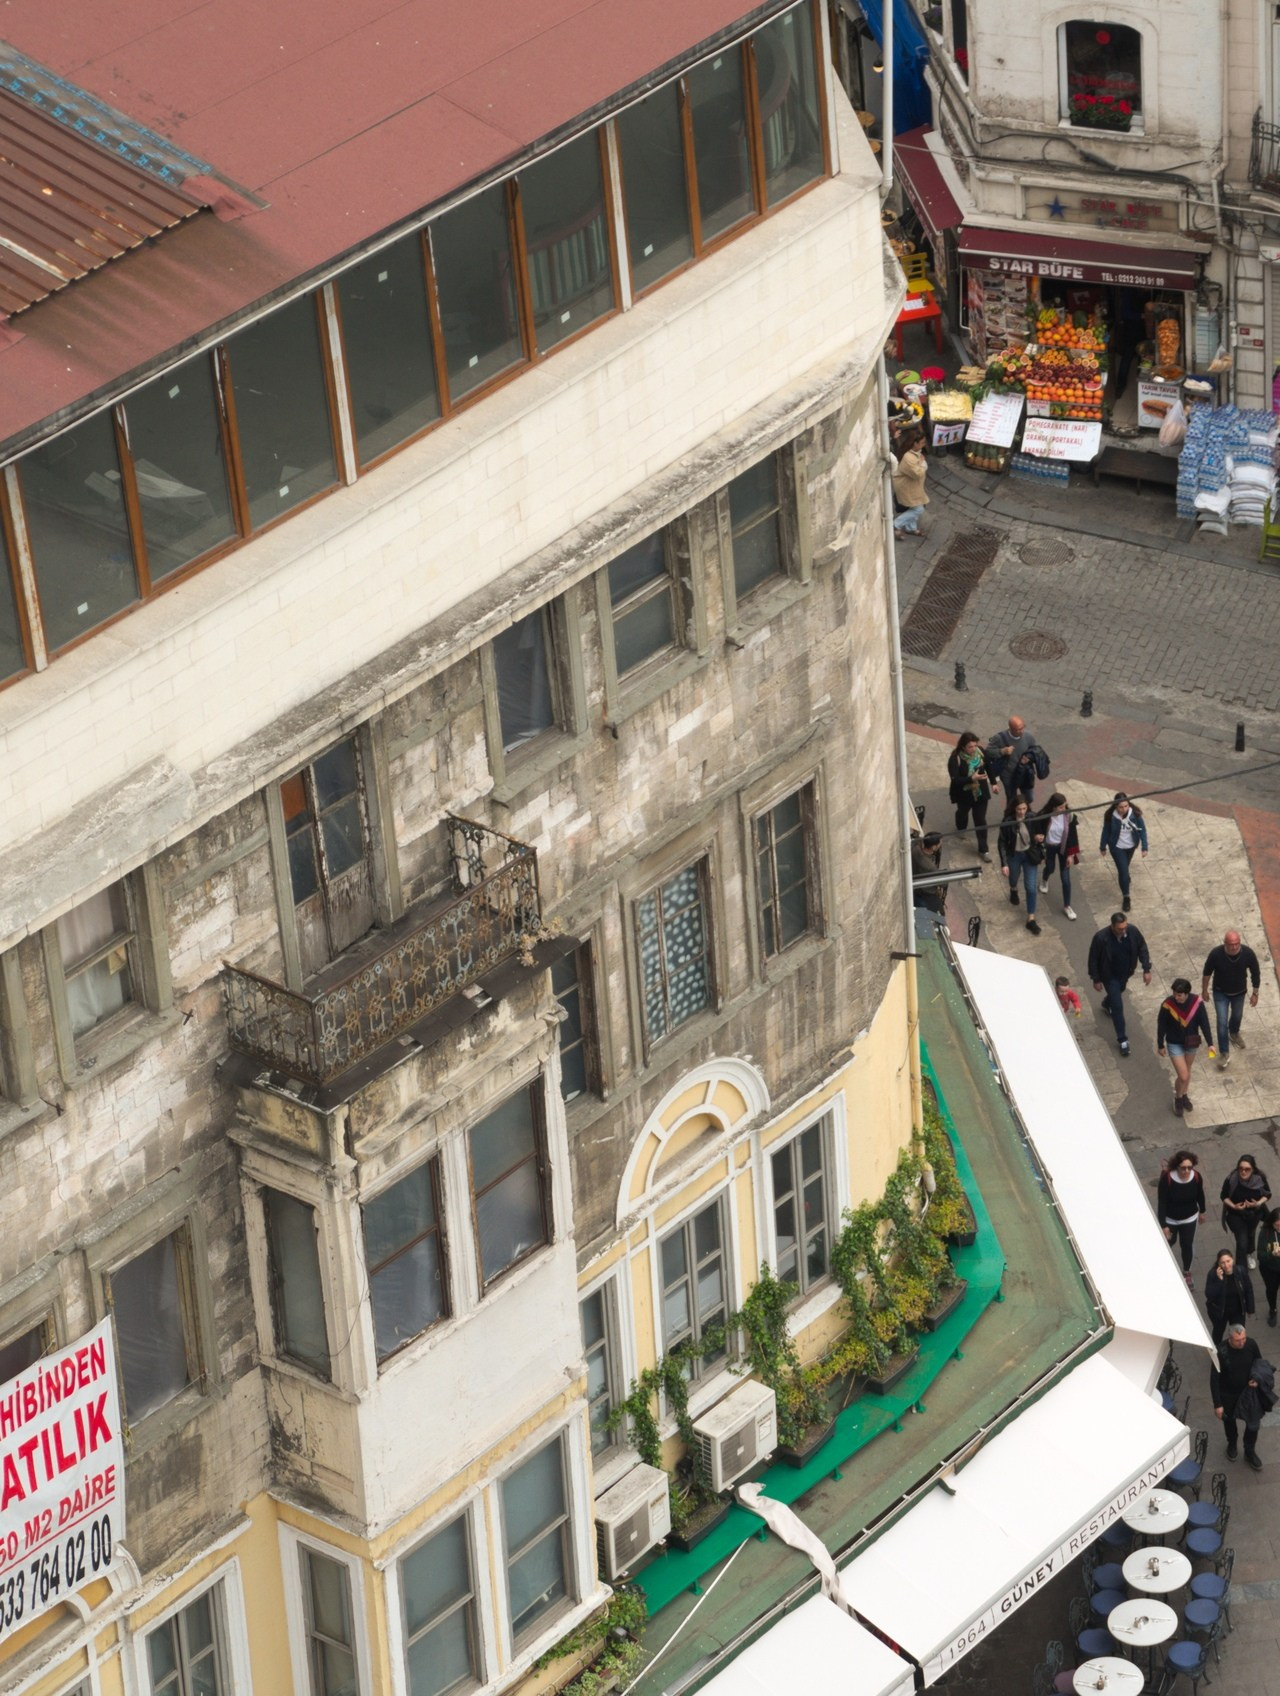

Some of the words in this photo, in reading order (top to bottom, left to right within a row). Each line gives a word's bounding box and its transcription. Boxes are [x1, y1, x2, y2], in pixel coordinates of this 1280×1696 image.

[989, 257, 1034, 274] STAR
[1038, 261, 1084, 279] BÜFE
[1118, 274, 1134, 284] 0212
[1028, 420, 1069, 431] POMEGRANATE
[0, 1337, 106, 1441] HİBİNDEN
[24, 1509, 52, 1550] M2
[58, 1464, 116, 1527] DAİRE
[31, 1544, 60, 1610] 764
[65, 1530, 85, 1588] 02
[91, 1514, 112, 1571] 00
[950, 1620, 987, 1659] 1964
[1001, 1558, 1054, 1613] GÜNEY
[1069, 1459, 1167, 1554] RESTAURANT
